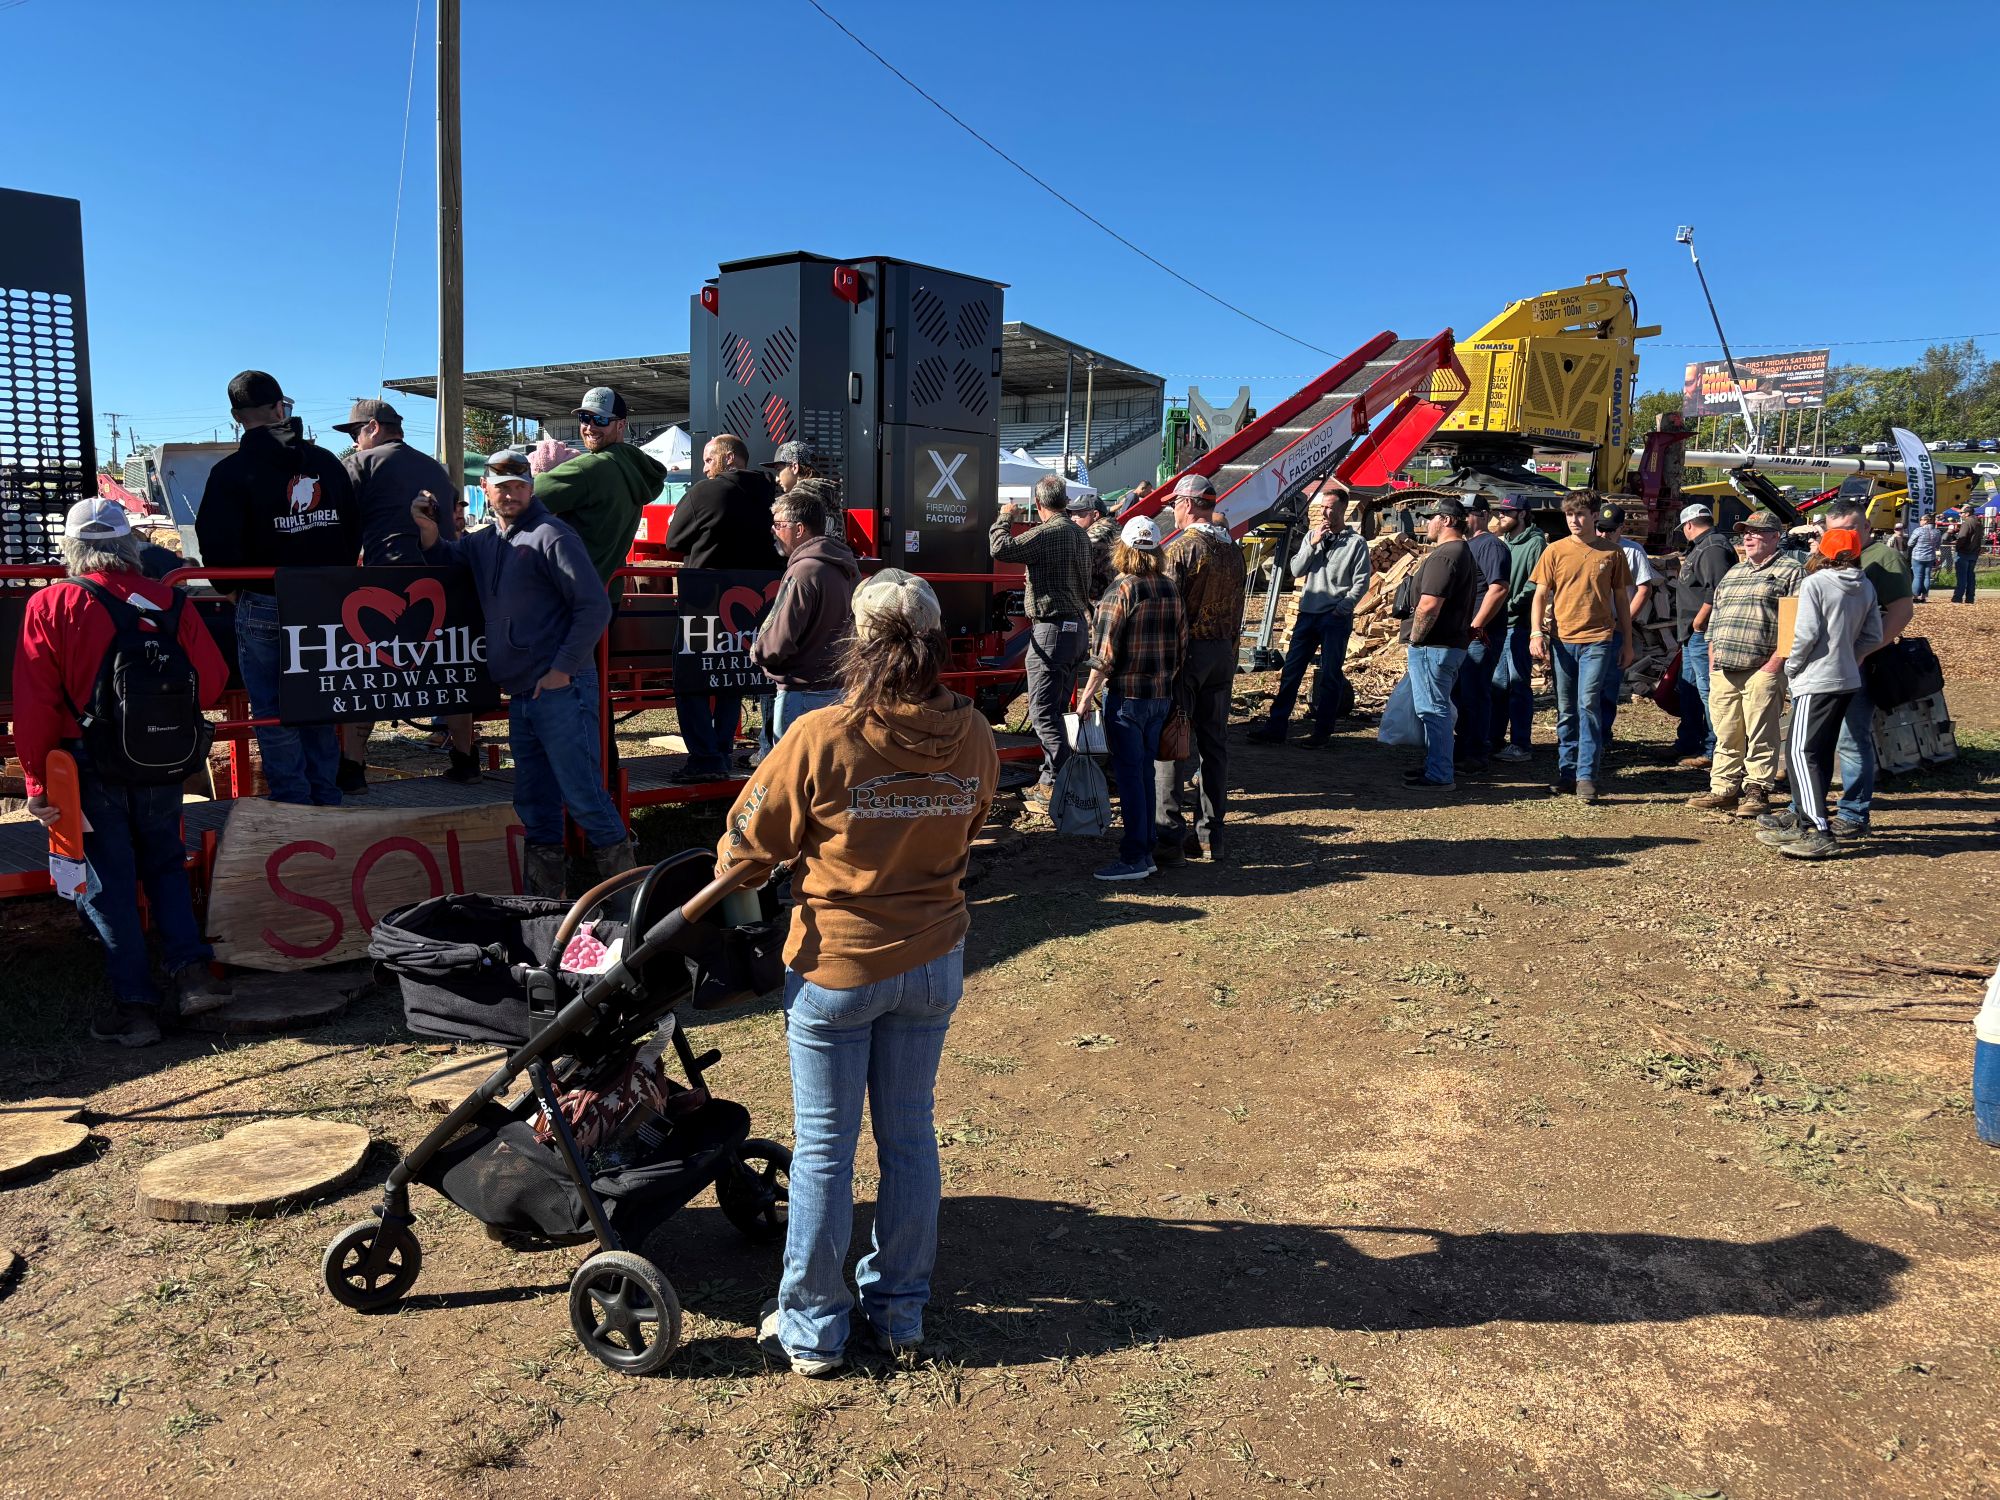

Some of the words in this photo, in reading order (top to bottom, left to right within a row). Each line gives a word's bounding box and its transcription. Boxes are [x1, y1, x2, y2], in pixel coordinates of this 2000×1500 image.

[1540, 299, 1558, 309] STAY
[1561, 295, 1580, 305] BACK
[1540, 309, 1561, 321] 330FT
[1563, 304, 1582, 317] 100M
[1474, 342, 1514, 350] KOMATSU
[1790, 354, 1826, 364] SATURDAY
[1793, 361, 1826, 370] OCTOBER
[1702, 372, 1731, 384] PAUL
[1705, 365, 1720, 374] THE
[1704, 392, 1741, 404] SHOW
[1611, 368, 1623, 447] KOMATSU
[1544, 427, 1581, 439] KOMATSU
[1288, 426, 1333, 465] FIREWOOD
[1289, 440, 1333, 482] FACTORY
[1918, 454, 1934, 505] Service
[926, 502, 968, 514] FIREWOOD
[273, 514, 306, 529] TRIPLE
[306, 508, 340, 524] THREA
[926, 513, 967, 524] FACTORY
[282, 624, 488, 675] Hartville
[318, 667, 478, 692] HARDWARE
[847, 787, 977, 809] Petrarca
[728, 782, 768, 847] Tree
[537, 1096, 552, 1121] Joie
